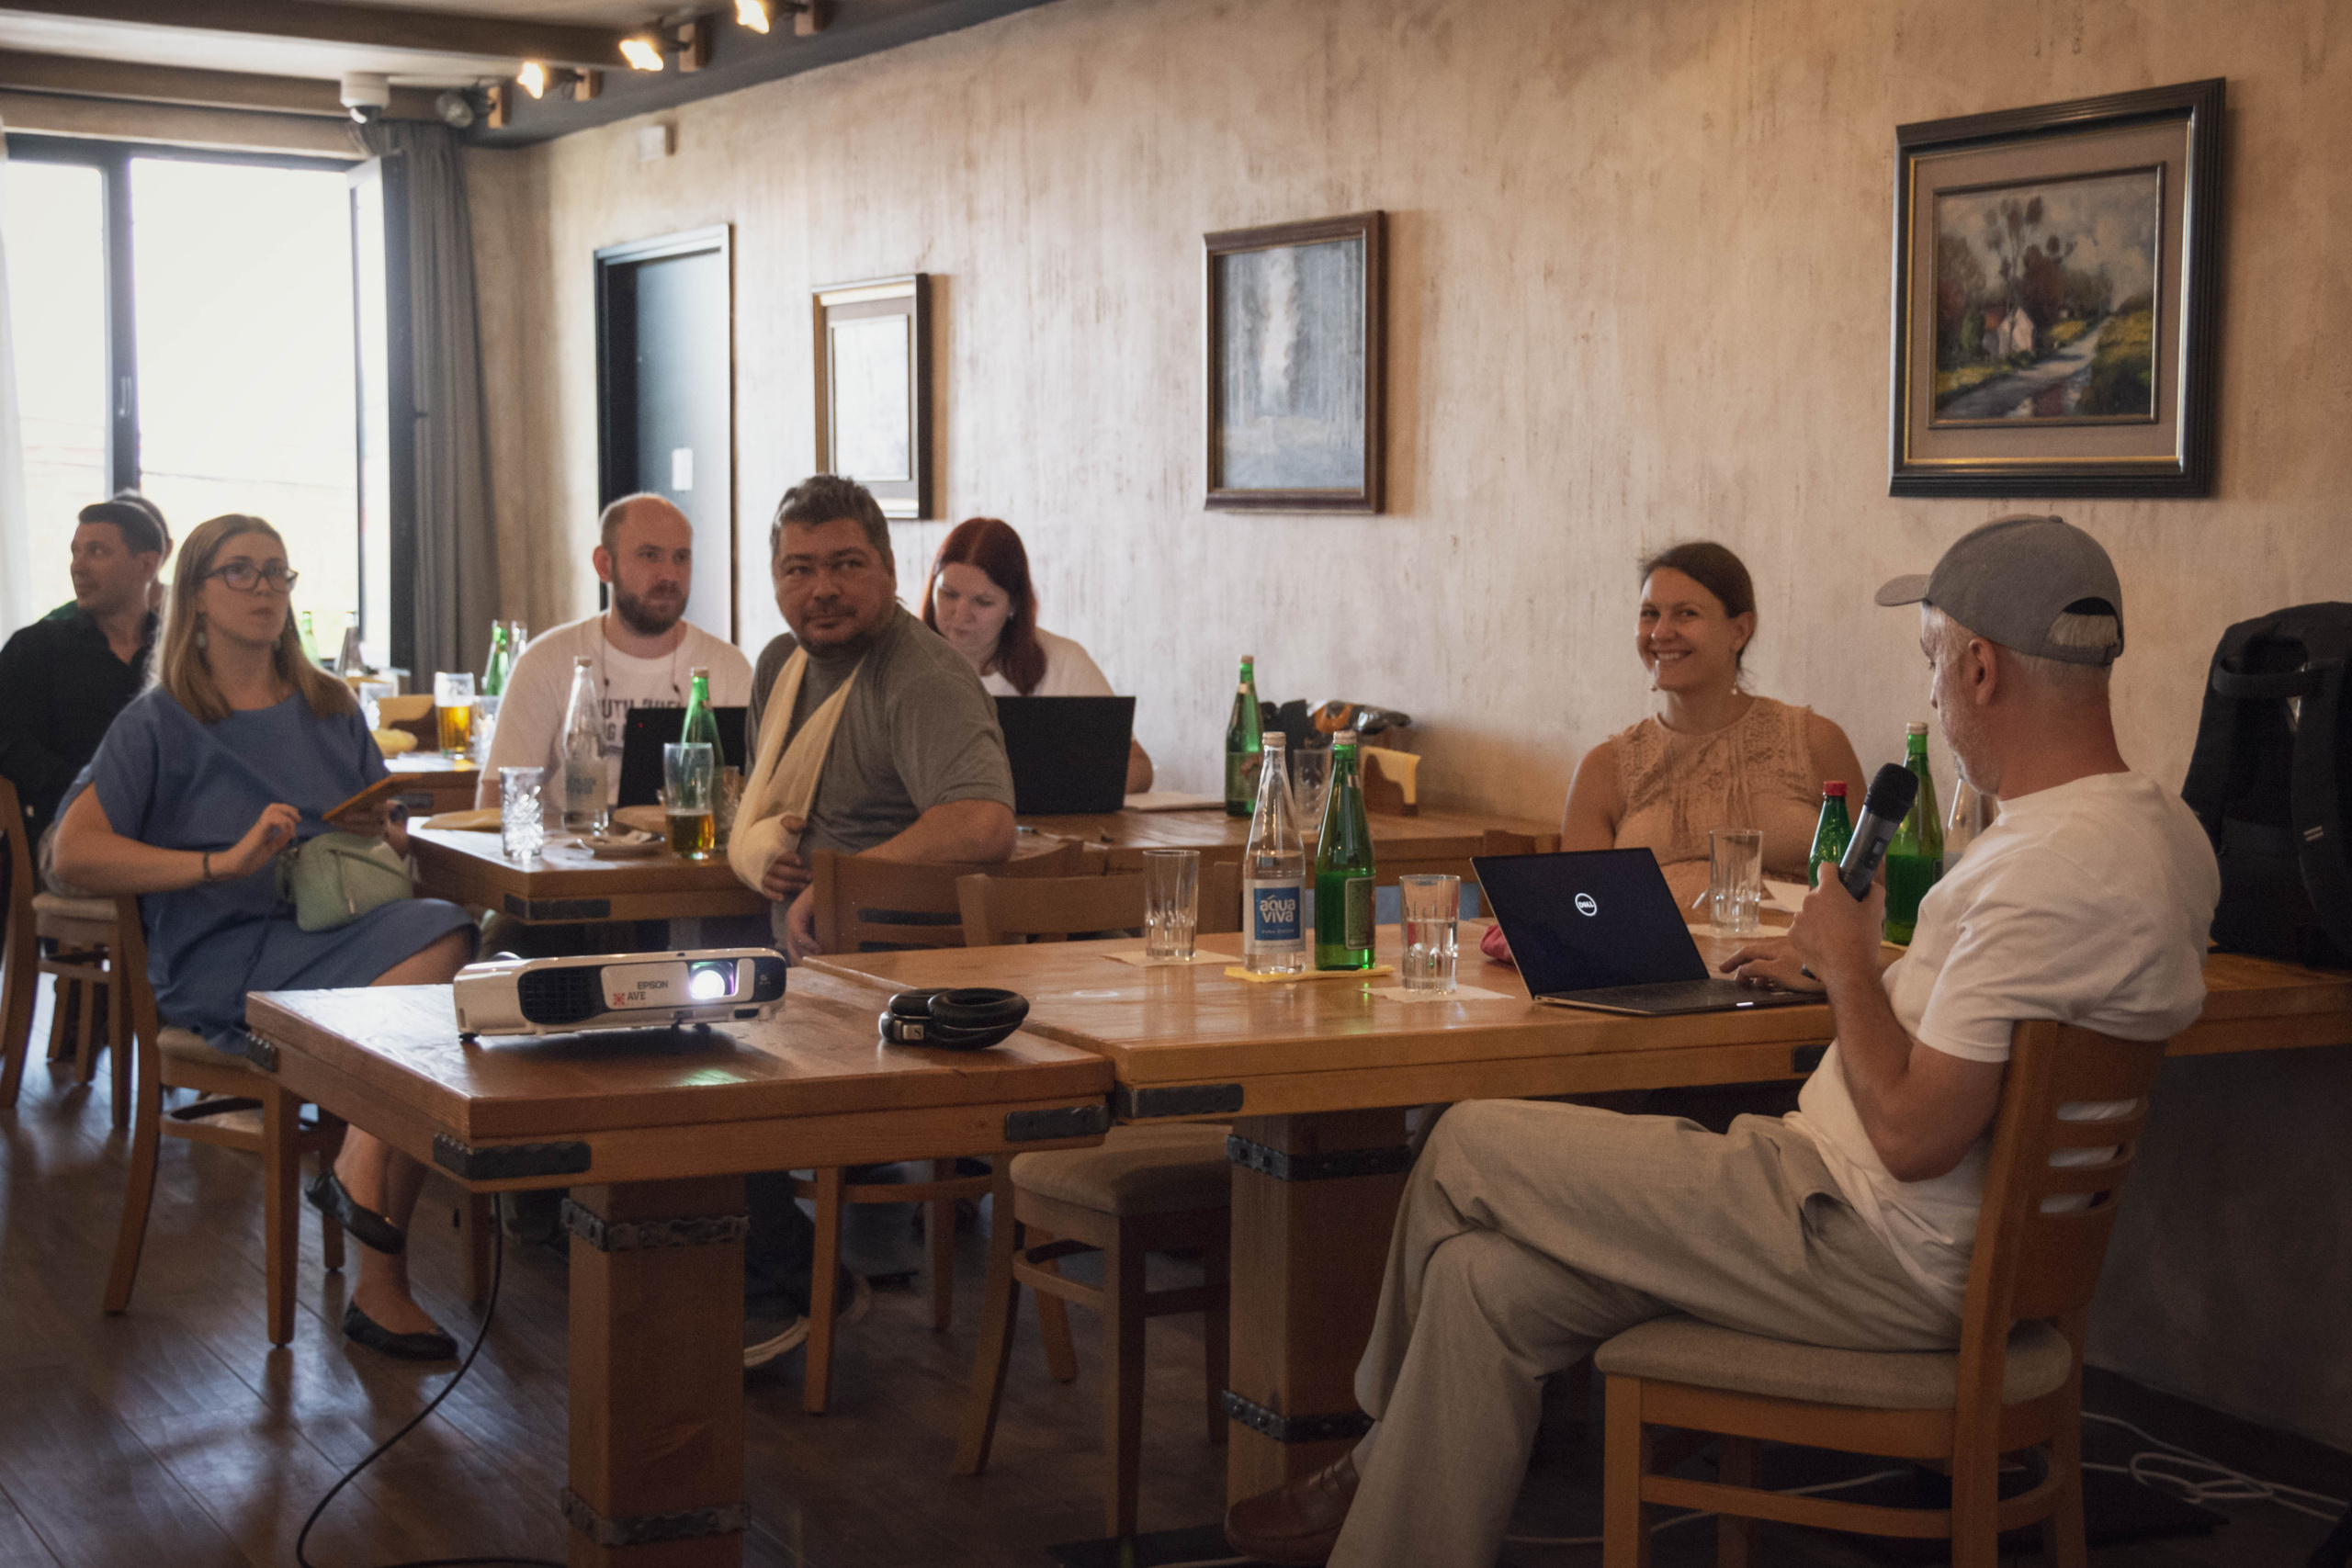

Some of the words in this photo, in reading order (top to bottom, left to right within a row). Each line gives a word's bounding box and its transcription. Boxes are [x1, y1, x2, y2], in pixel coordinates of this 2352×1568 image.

[1261, 910, 1294, 923] viva
[637, 980, 669, 990] EPSON
[628, 991, 646, 1000] AVE
